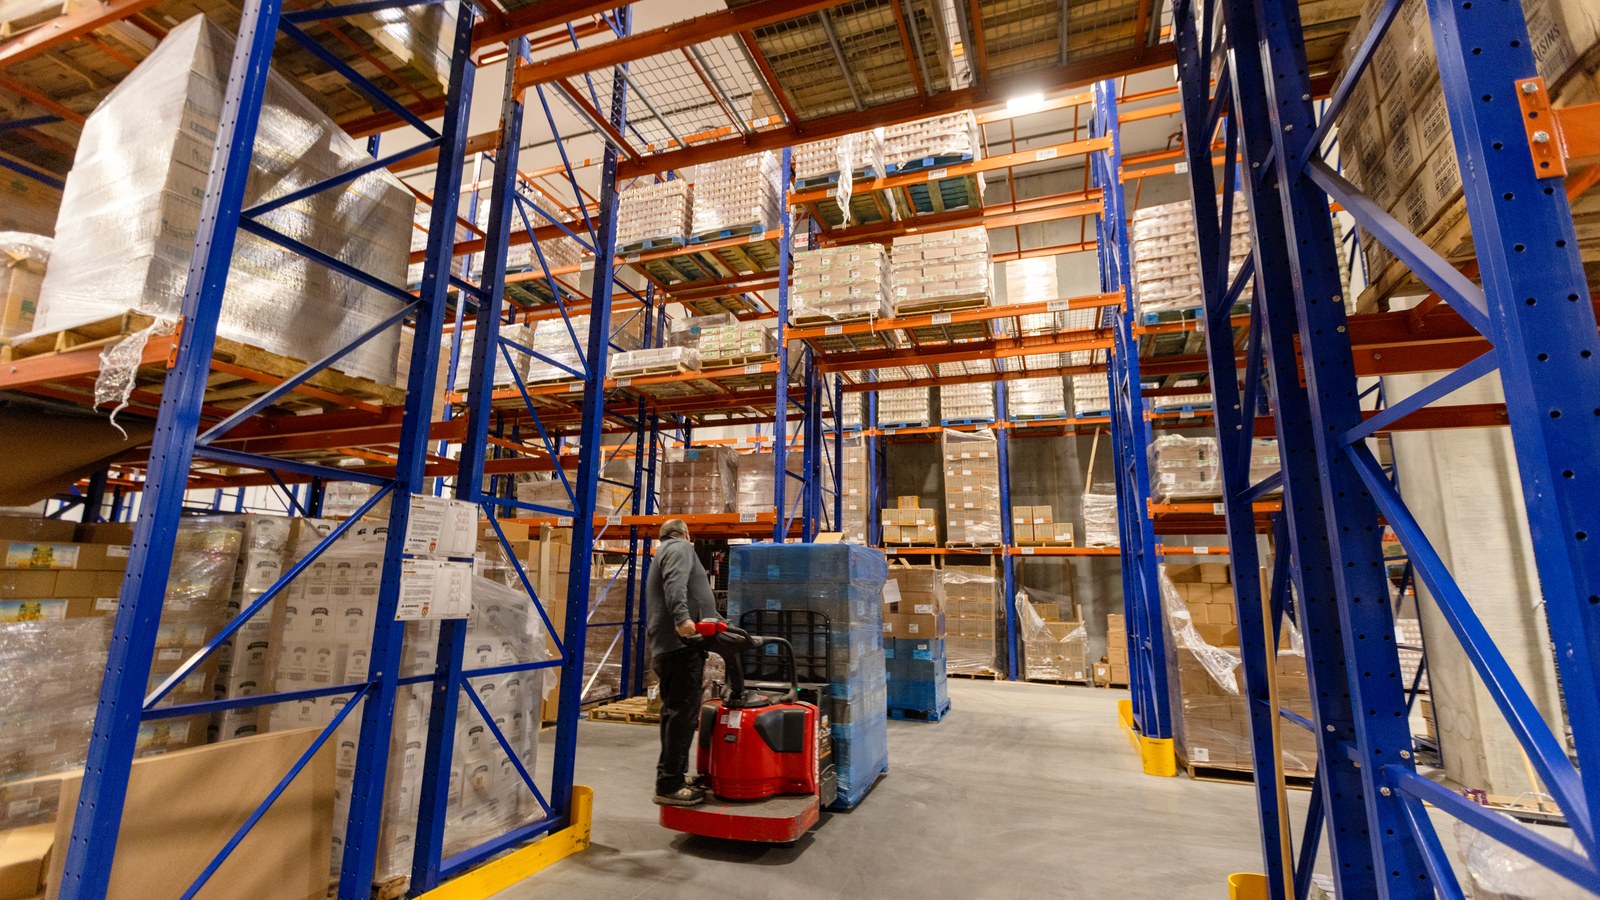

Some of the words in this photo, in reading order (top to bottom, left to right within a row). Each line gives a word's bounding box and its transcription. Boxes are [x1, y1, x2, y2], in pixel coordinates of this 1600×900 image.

[1533, 23, 1561, 62] AISINS
[1423, 99, 1442, 127] FRAGILE
[1435, 155, 1452, 179] FRAGILE
